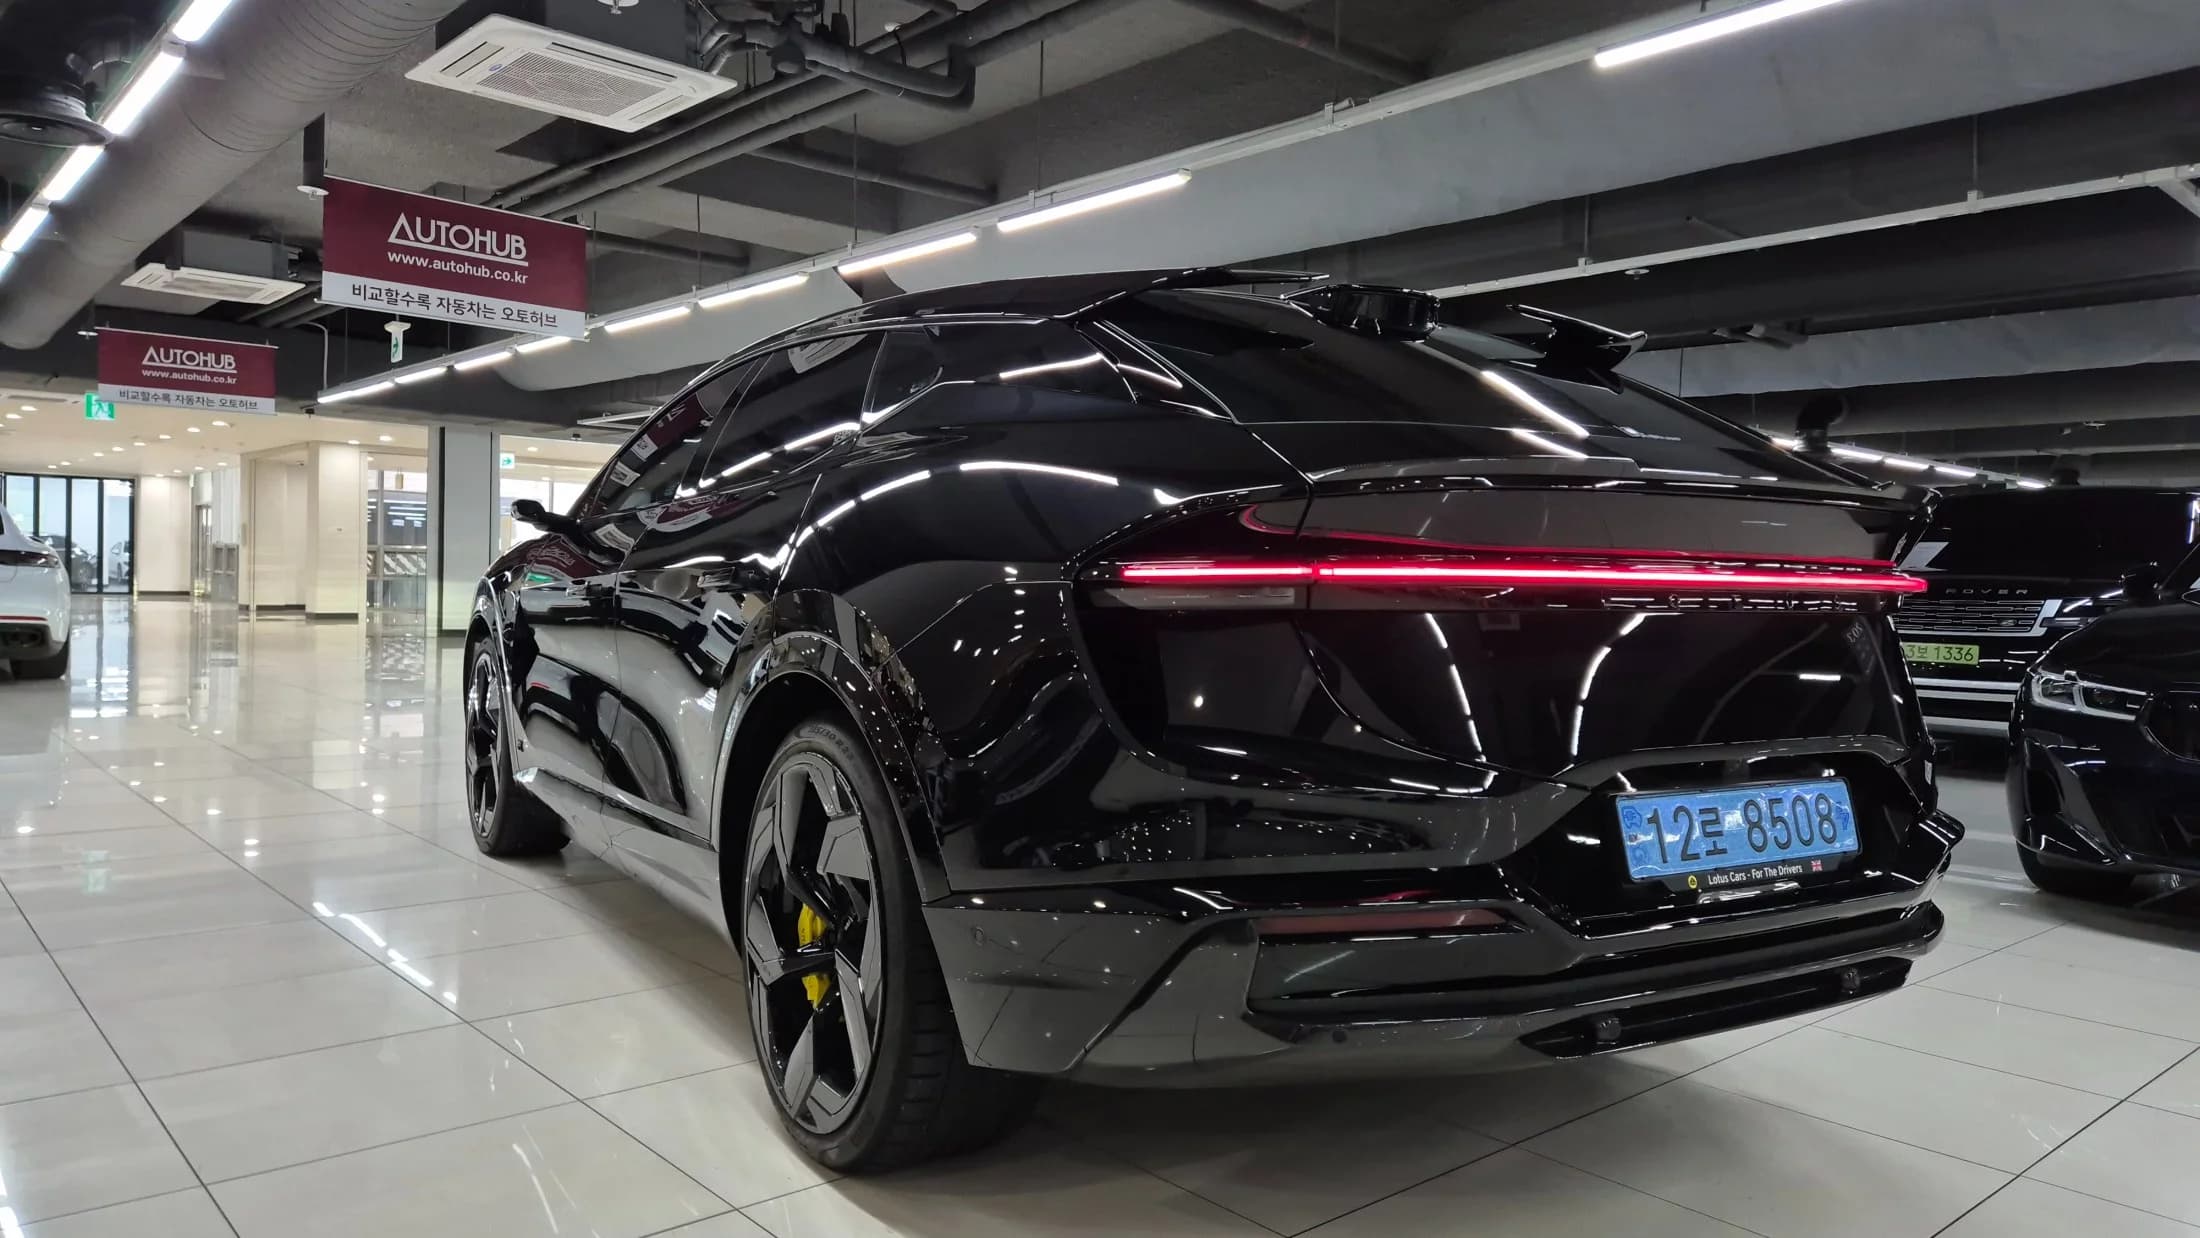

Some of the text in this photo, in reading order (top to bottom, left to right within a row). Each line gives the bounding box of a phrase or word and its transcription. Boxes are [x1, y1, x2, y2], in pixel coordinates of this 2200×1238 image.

[387, 212, 528, 263] AUTOHUB
[387, 251, 528, 285] www.autohub.co.kr
[352, 283, 558, 328] 비교할수록 자동차는 오토허브
[142, 345, 237, 371] AUTOHUB
[142, 368, 237, 385] www.autohub.co.kr
[119, 389, 258, 410] 비교할수록 자동차는 오토허브
[1934, 646, 1974, 661] 1336
[1647, 793, 1838, 864] 12로 8508
[1708, 873, 1728, 885] Lotus
[1730, 872, 1746, 882] Cars
[1752, 869, 1763, 879] For
[1764, 867, 1777, 877] The
[1778, 864, 1803, 876] Drivers
